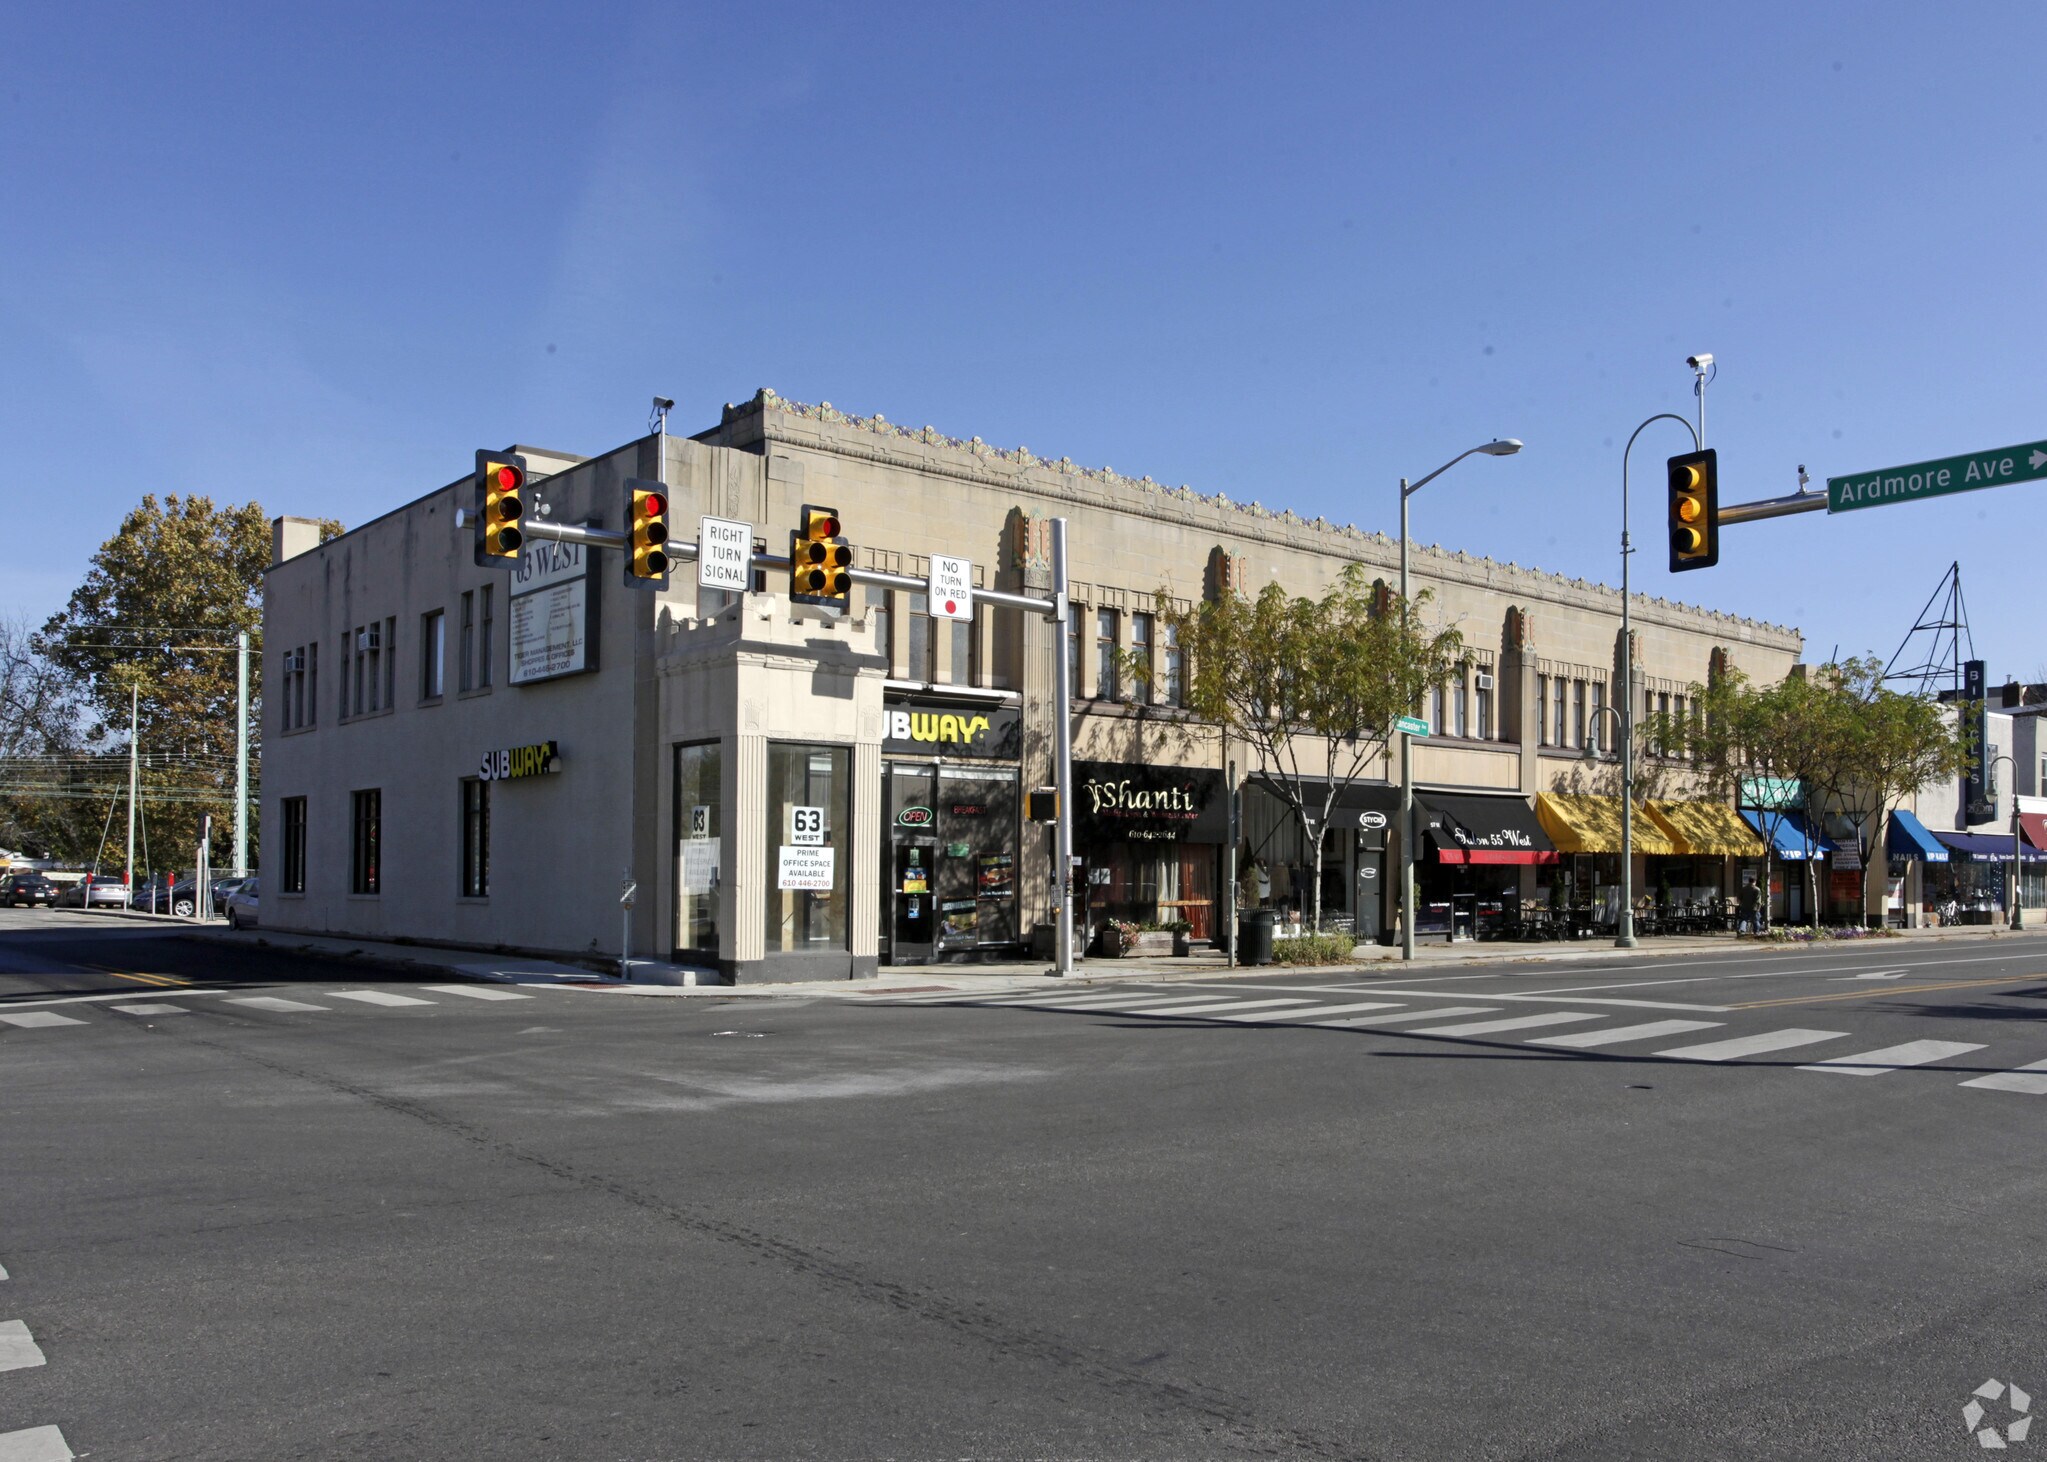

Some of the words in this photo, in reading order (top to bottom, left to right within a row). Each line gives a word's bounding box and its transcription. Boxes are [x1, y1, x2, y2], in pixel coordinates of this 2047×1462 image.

[1840, 468, 1951, 503] Ardmore
[1965, 457, 2014, 483] Ave
[710, 526, 744, 543] RIGHT
[712, 545, 741, 562] TURN
[705, 564, 745, 583] SIGNAL
[943, 561, 958, 573] NO
[940, 574, 962, 586] TURN
[935, 586, 946, 597] ON
[950, 589, 967, 599] RED
[478, 743, 550, 781] SUBWAY
[1102, 780, 1194, 811] Shanti
[693, 810, 705, 832] 63
[795, 810, 820, 832] 63
[903, 811, 927, 821] OPEN
[1491, 834, 1504, 846] 55
[1501, 829, 1532, 846] West
[1781, 850, 1802, 859] VIP
[1893, 853, 1919, 861] NAILS
